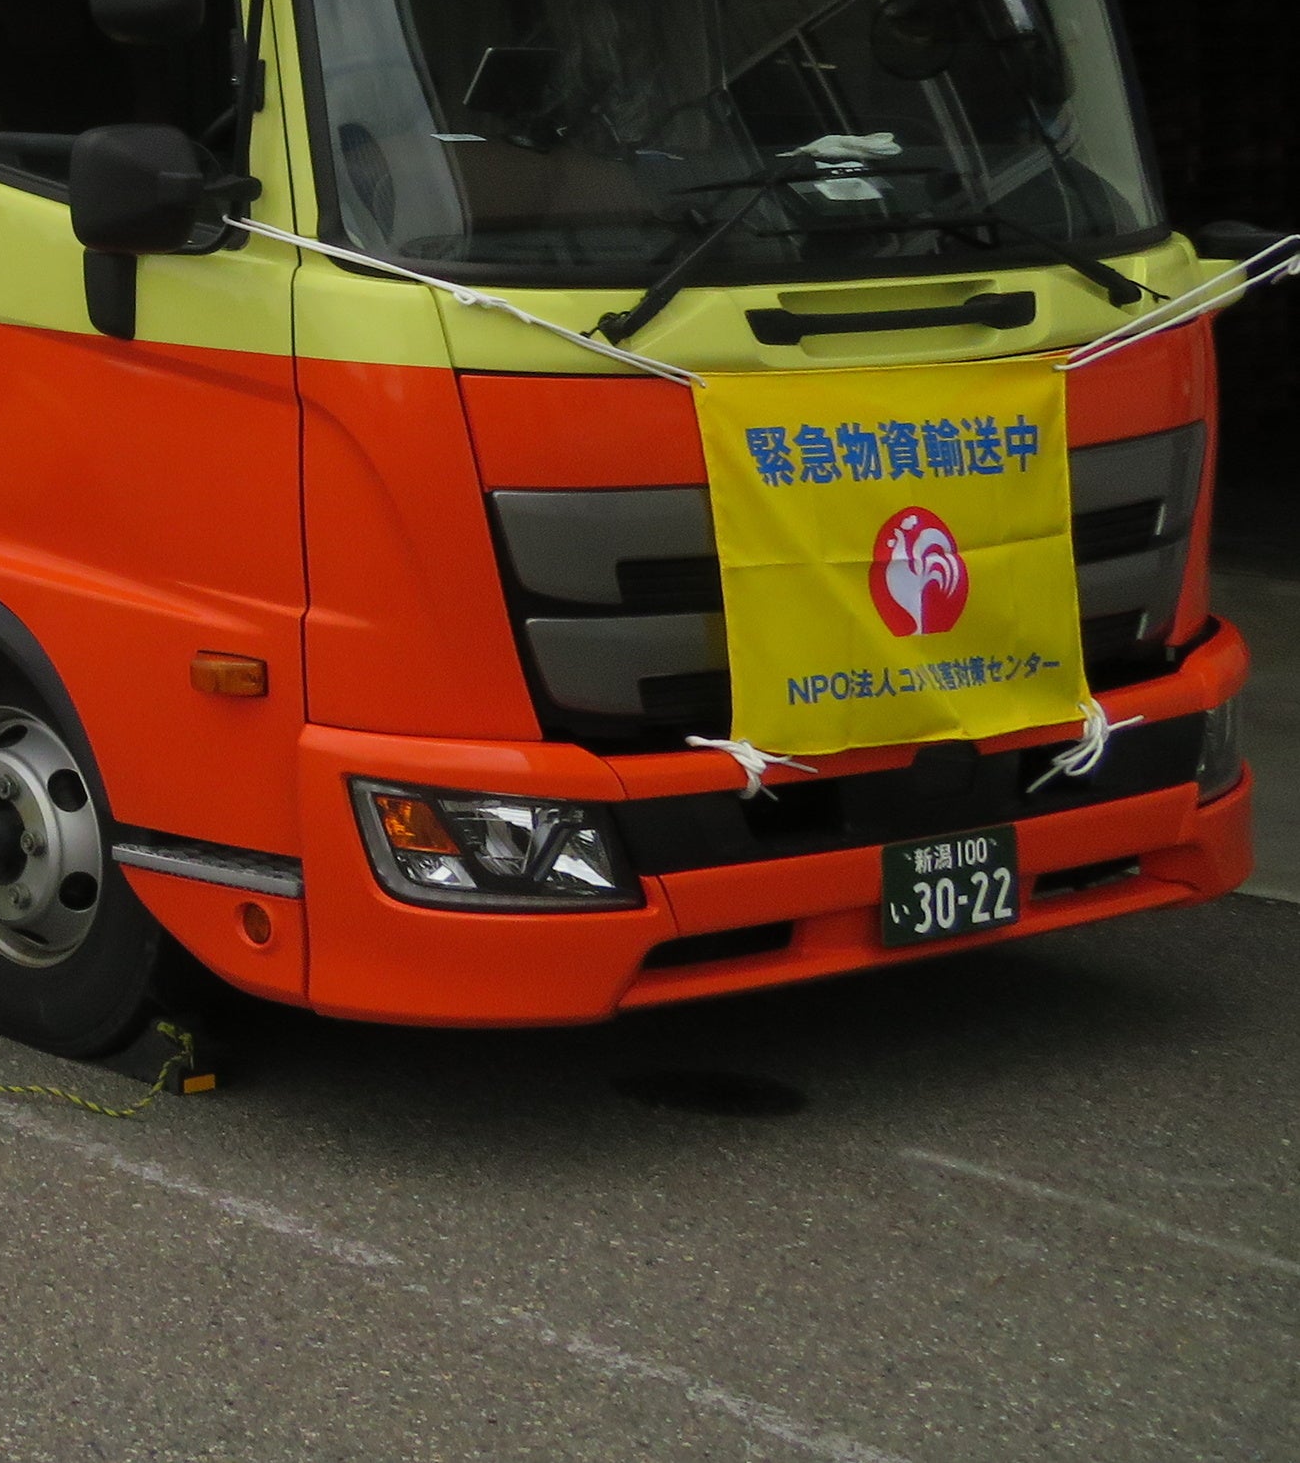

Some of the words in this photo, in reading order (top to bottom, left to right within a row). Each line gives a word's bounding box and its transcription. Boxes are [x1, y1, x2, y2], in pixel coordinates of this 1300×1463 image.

[745, 414, 1039, 487] 緊急物資輸送中
[890, 902, 911, 924] い
[913, 867, 1013, 934] 30-22
